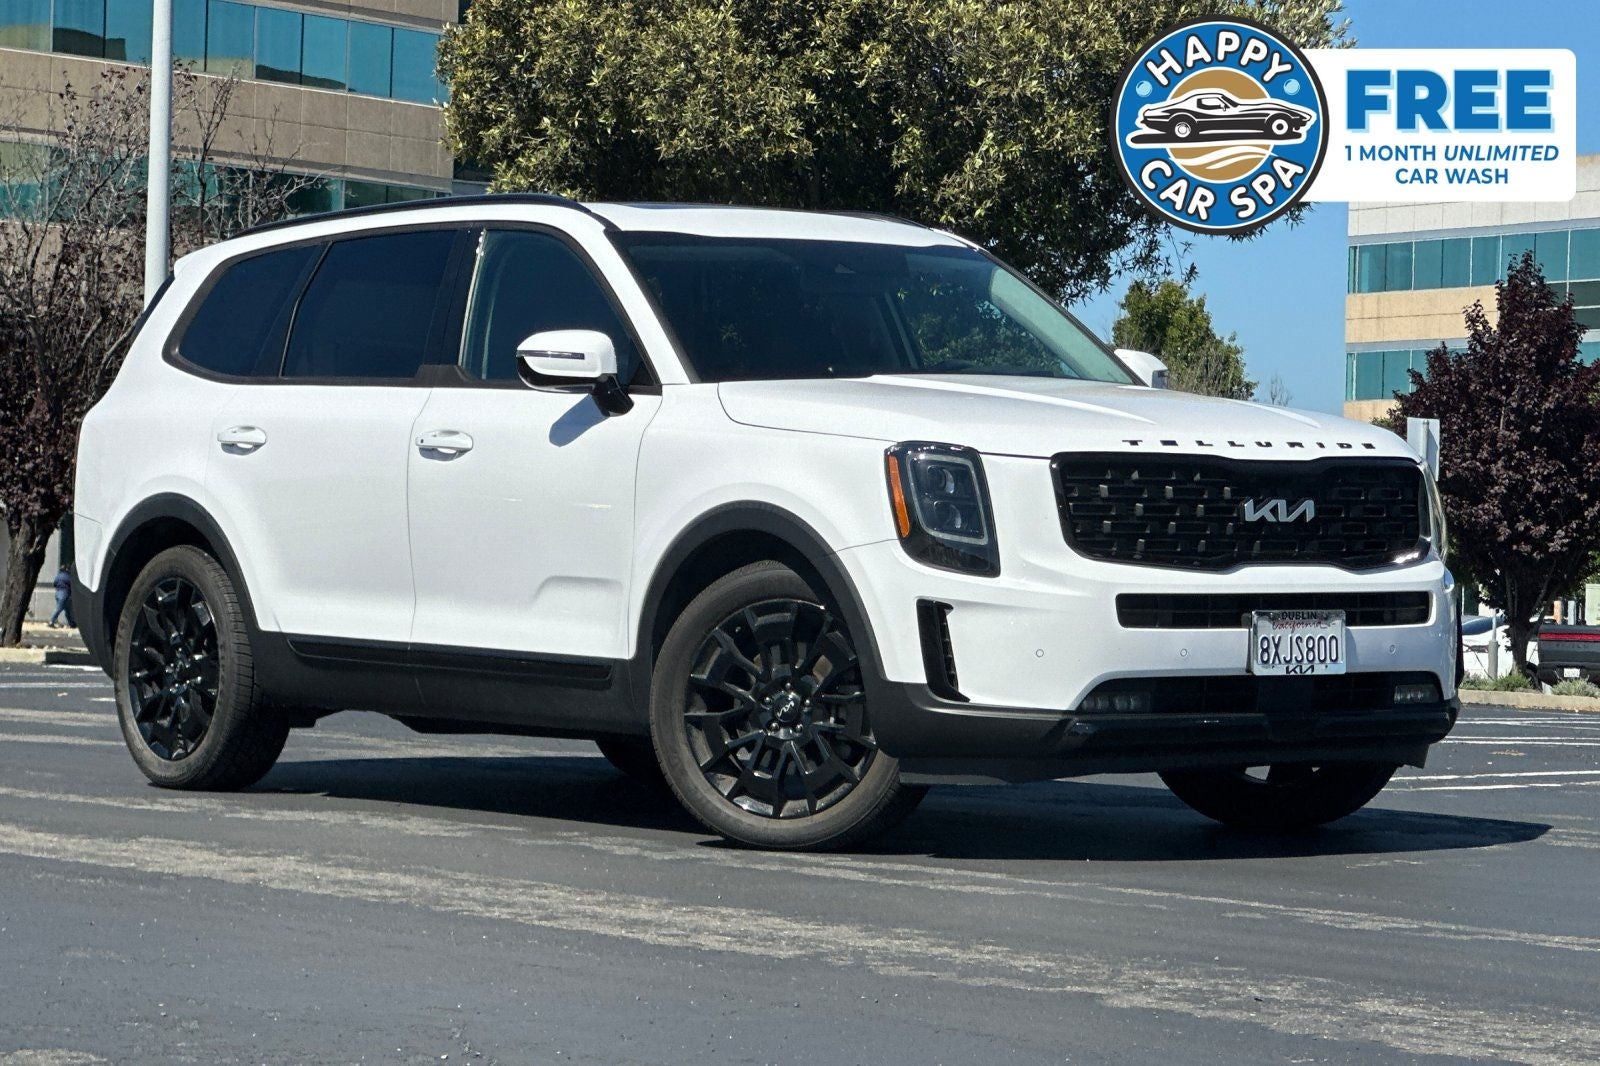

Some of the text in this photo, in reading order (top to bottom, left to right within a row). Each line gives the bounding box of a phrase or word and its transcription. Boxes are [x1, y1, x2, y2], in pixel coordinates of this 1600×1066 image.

[1121, 439, 1377, 450] TELLURIDE
[1243, 498, 1316, 523] KIA
[1281, 610, 1318, 621] DUBLIN
[1259, 634, 1340, 665] 8XJS800
[1285, 664, 1315, 675] KIA
